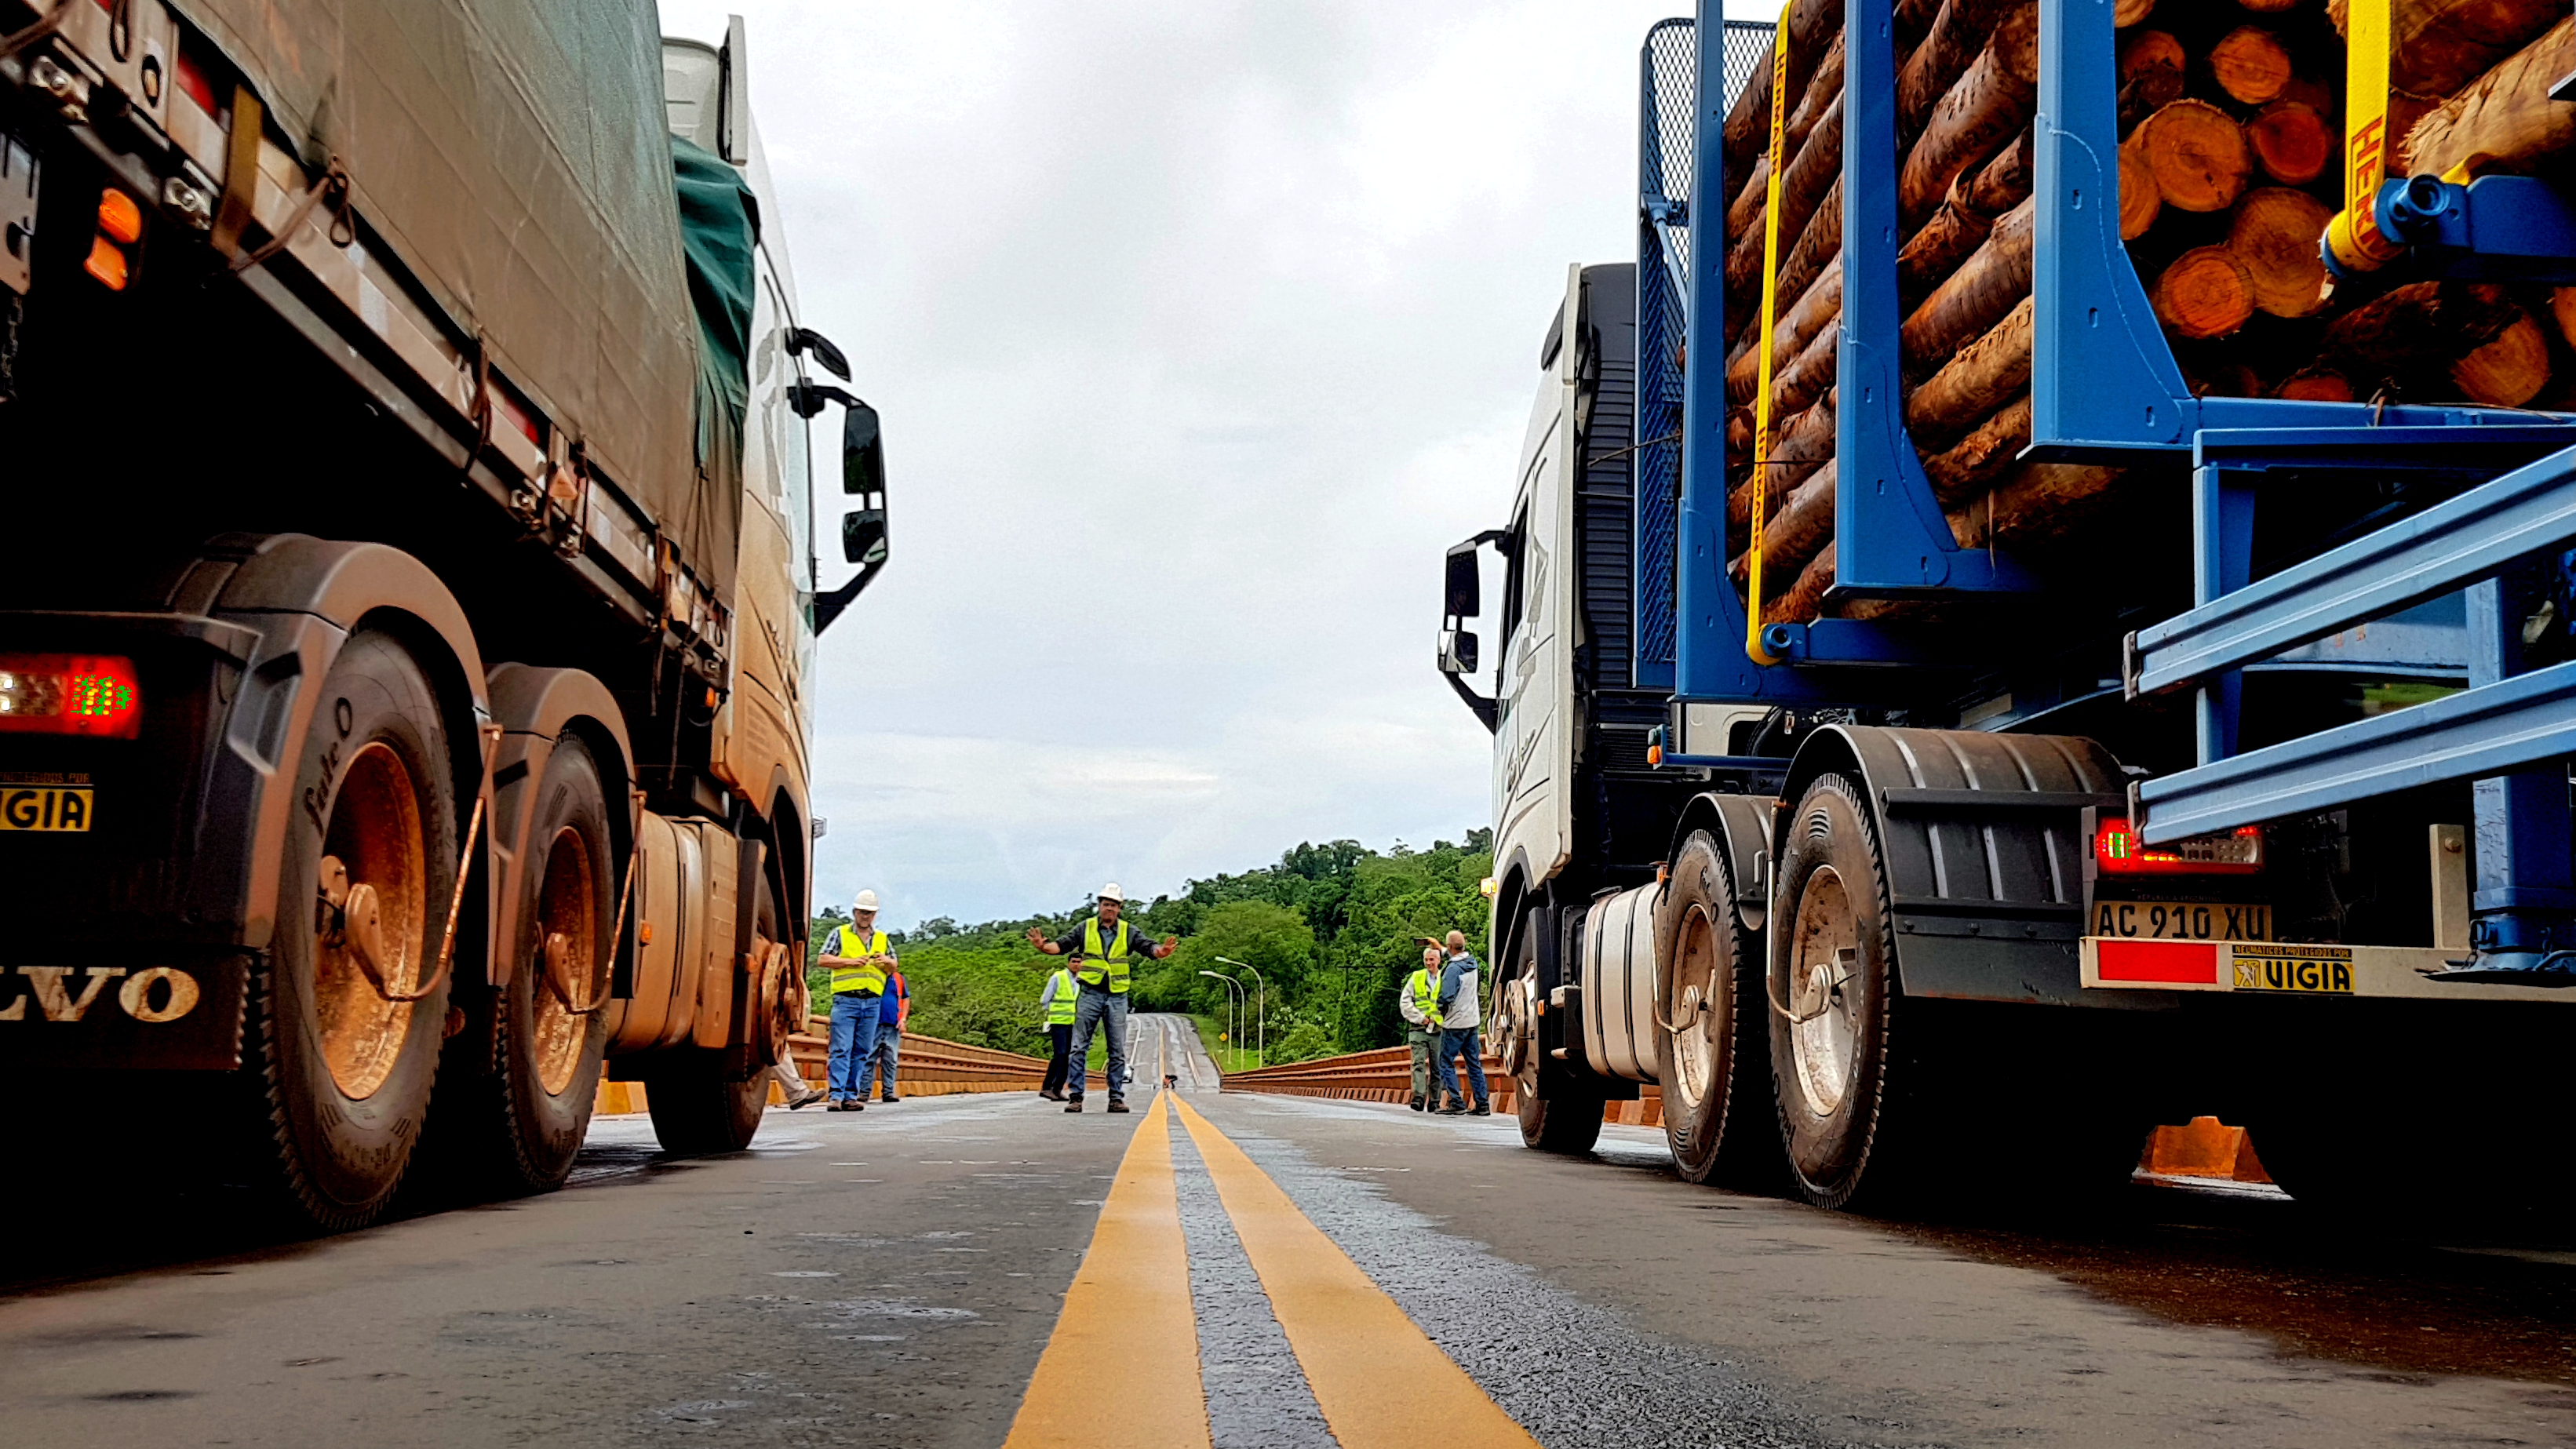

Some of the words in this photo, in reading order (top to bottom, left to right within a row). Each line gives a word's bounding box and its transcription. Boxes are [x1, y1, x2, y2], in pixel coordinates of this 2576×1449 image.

[1771, 52, 1786, 177] HERMANN
[0, 790, 84, 828] GIA
[2098, 905, 2137, 937] AC
[2150, 906, 2210, 938] 910
[2224, 907, 2264, 941] XU
[2235, 945, 2283, 955] NEUMATICOS
[2285, 946, 2331, 957] PROTEGIDOS
[2334, 948, 2348, 958] POR
[2265, 960, 2350, 990] VIGIA
